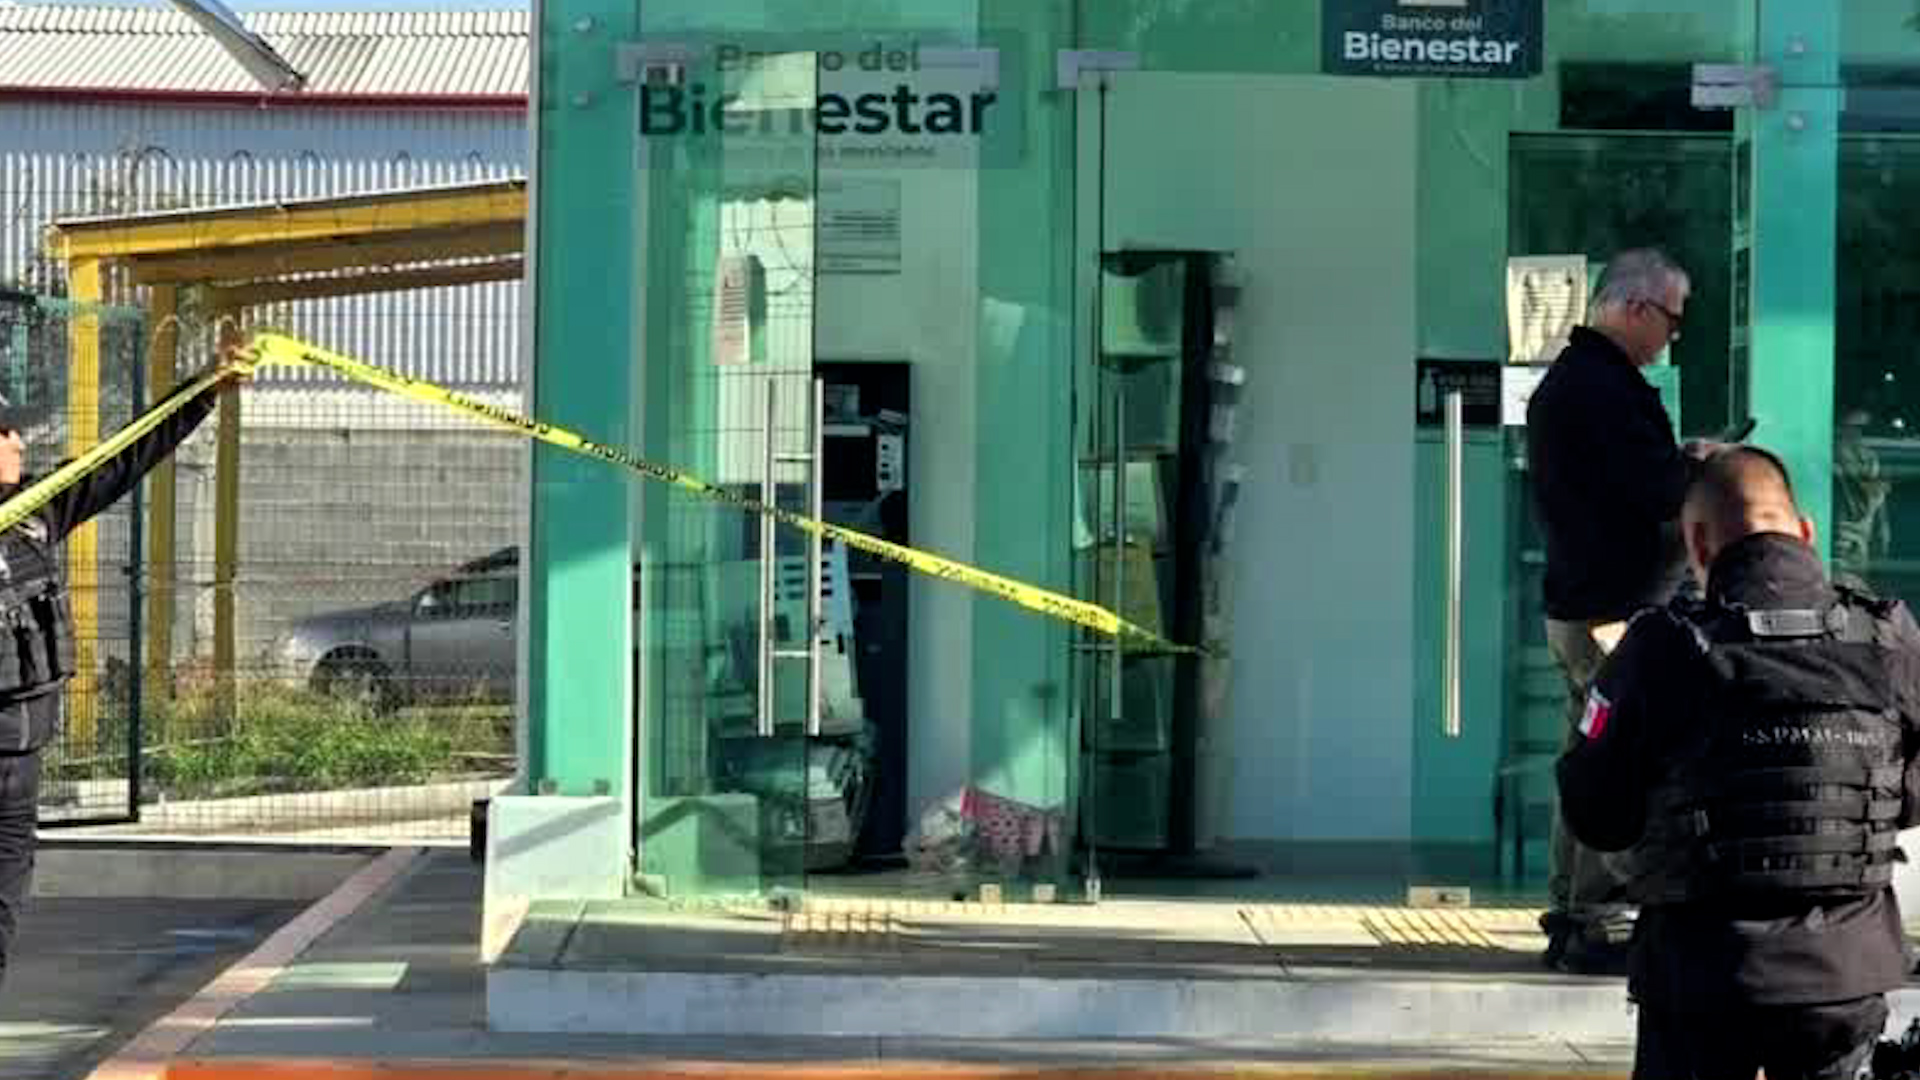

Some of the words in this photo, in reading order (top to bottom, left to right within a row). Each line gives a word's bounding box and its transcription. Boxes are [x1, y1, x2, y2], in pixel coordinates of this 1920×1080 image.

[1381, 14, 1447, 31] Banco
[1450, 14, 1484, 31] del
[859, 40, 921, 71] del
[1344, 31, 1519, 63] Bienestar
